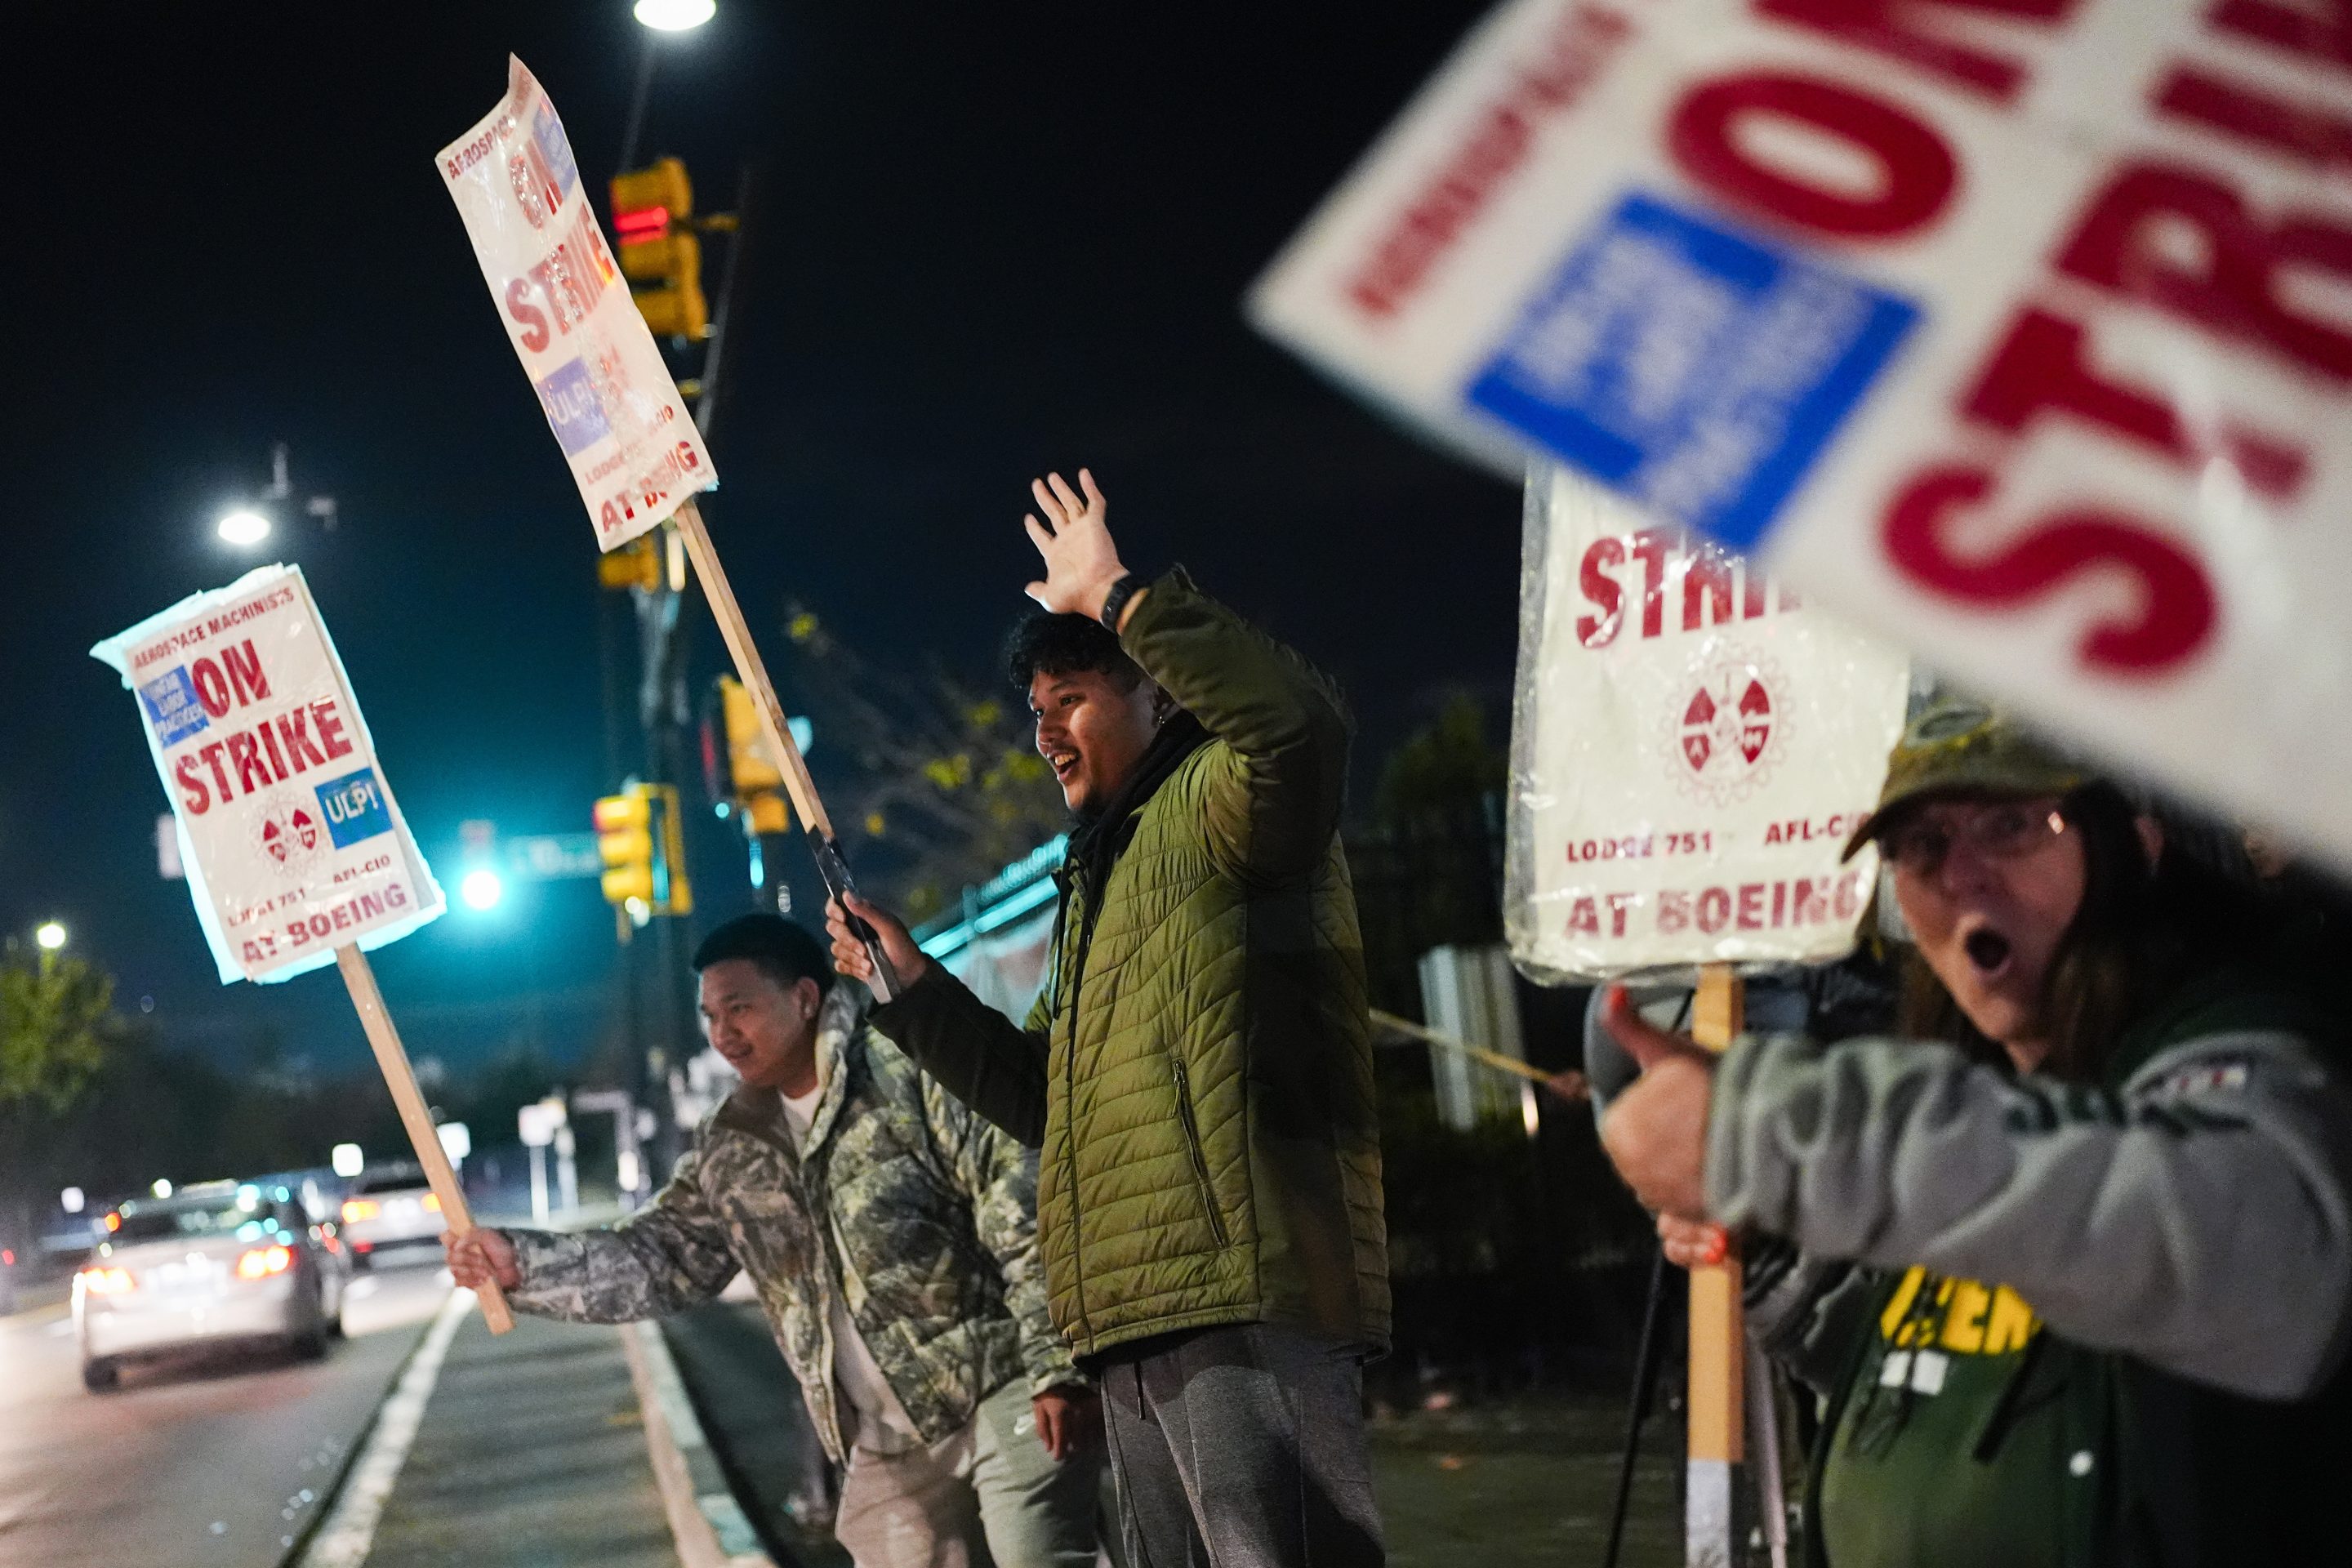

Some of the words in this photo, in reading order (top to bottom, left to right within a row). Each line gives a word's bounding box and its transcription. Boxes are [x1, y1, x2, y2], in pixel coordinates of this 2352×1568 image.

[447, 115, 515, 180] AEROSPAC
[600, 489, 635, 533] AT
[1575, 525, 1803, 650] STR
[134, 625, 206, 670] AEROSPACE
[207, 587, 295, 635] MACHINISTS
[192, 638, 271, 719] ON
[176, 698, 353, 816] STRIKE
[324, 782, 379, 824] ULP!
[332, 854, 391, 884] AFL-CIO
[1665, 830, 1714, 856] 751
[287, 882, 408, 947] BOEING
[1563, 893, 1636, 940] AT
